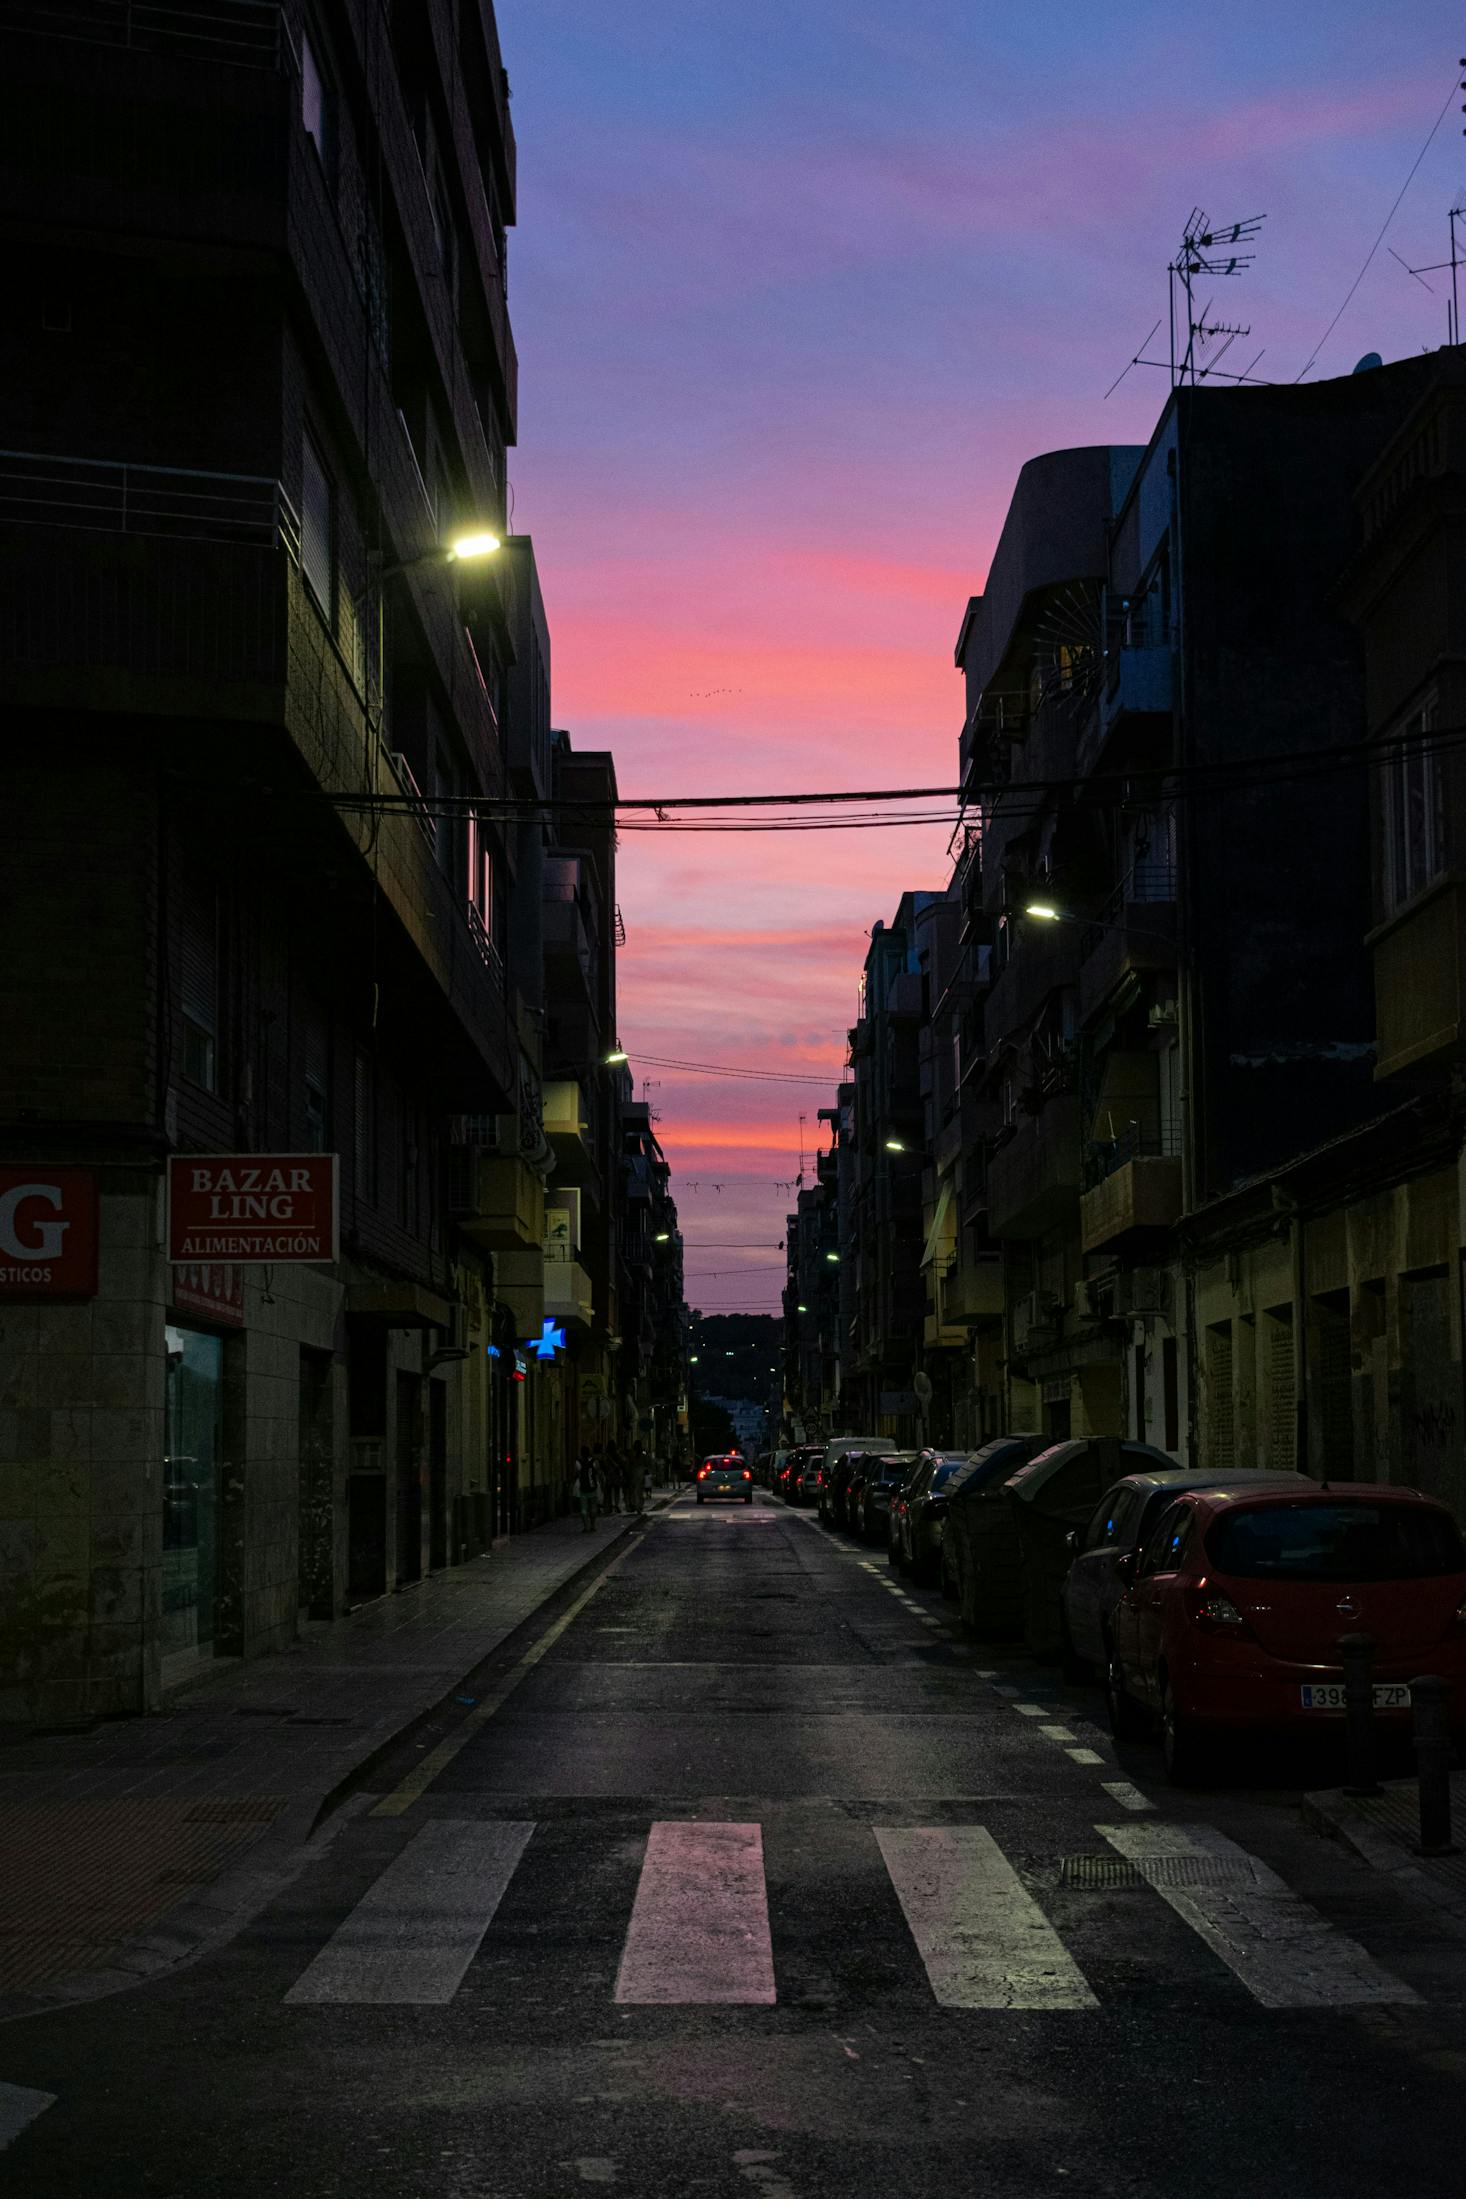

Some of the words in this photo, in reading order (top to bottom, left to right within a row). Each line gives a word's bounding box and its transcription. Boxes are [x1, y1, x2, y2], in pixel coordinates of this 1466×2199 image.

[191, 1168, 314, 1192] BAZAR
[209, 1195, 295, 1220] LING
[0, 1183, 71, 1261] G
[180, 1232, 321, 1253] ALIMENTACIÓN
[0, 1266, 52, 1283] STICOS
